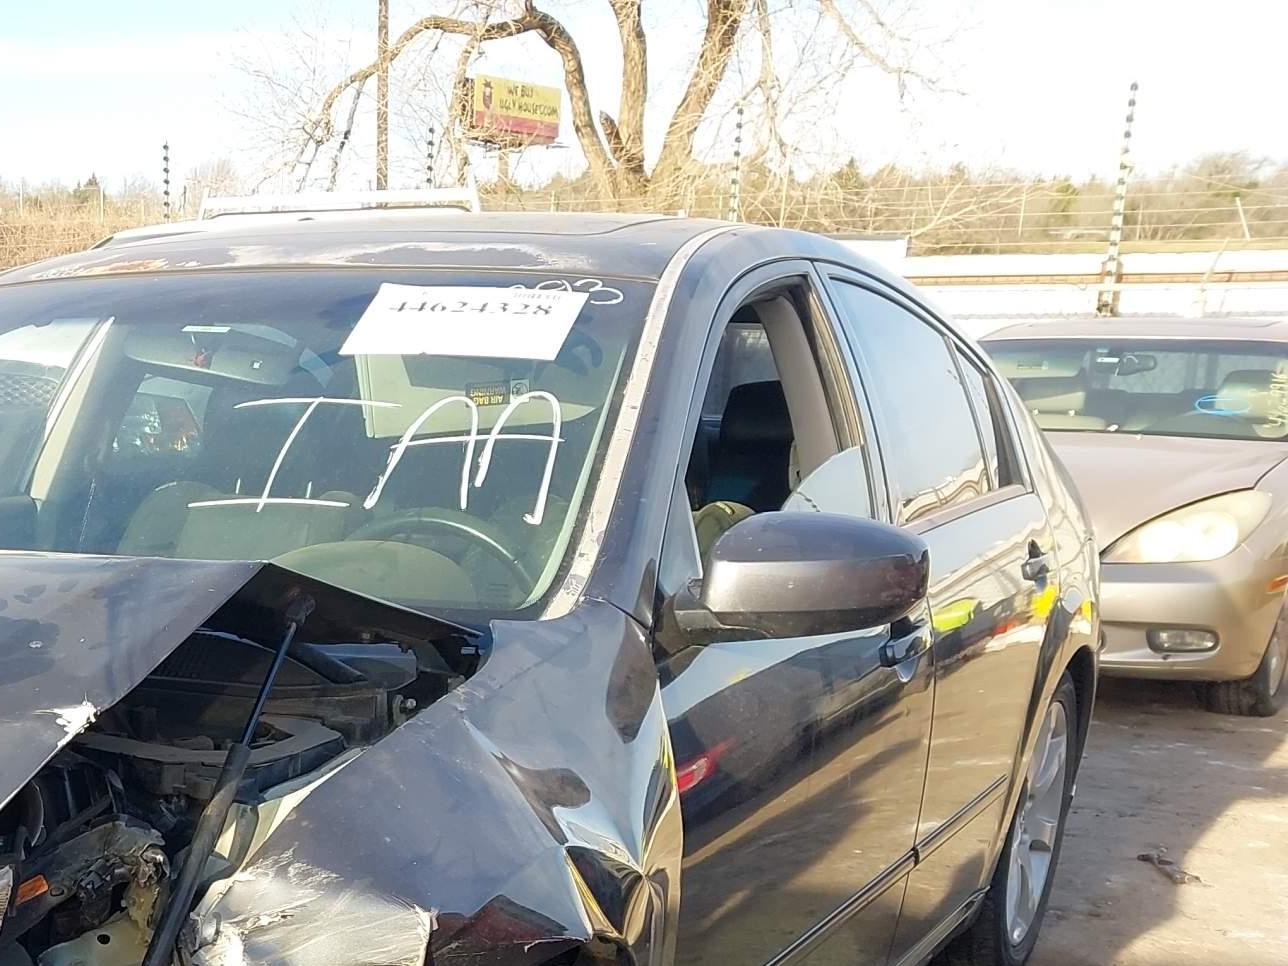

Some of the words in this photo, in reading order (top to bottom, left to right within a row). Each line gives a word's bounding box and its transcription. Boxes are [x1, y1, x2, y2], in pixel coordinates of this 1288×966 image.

[388, 300, 554, 316] 44624328
[473, 395, 490, 405] BAG
[490, 394, 504, 404] AIR
